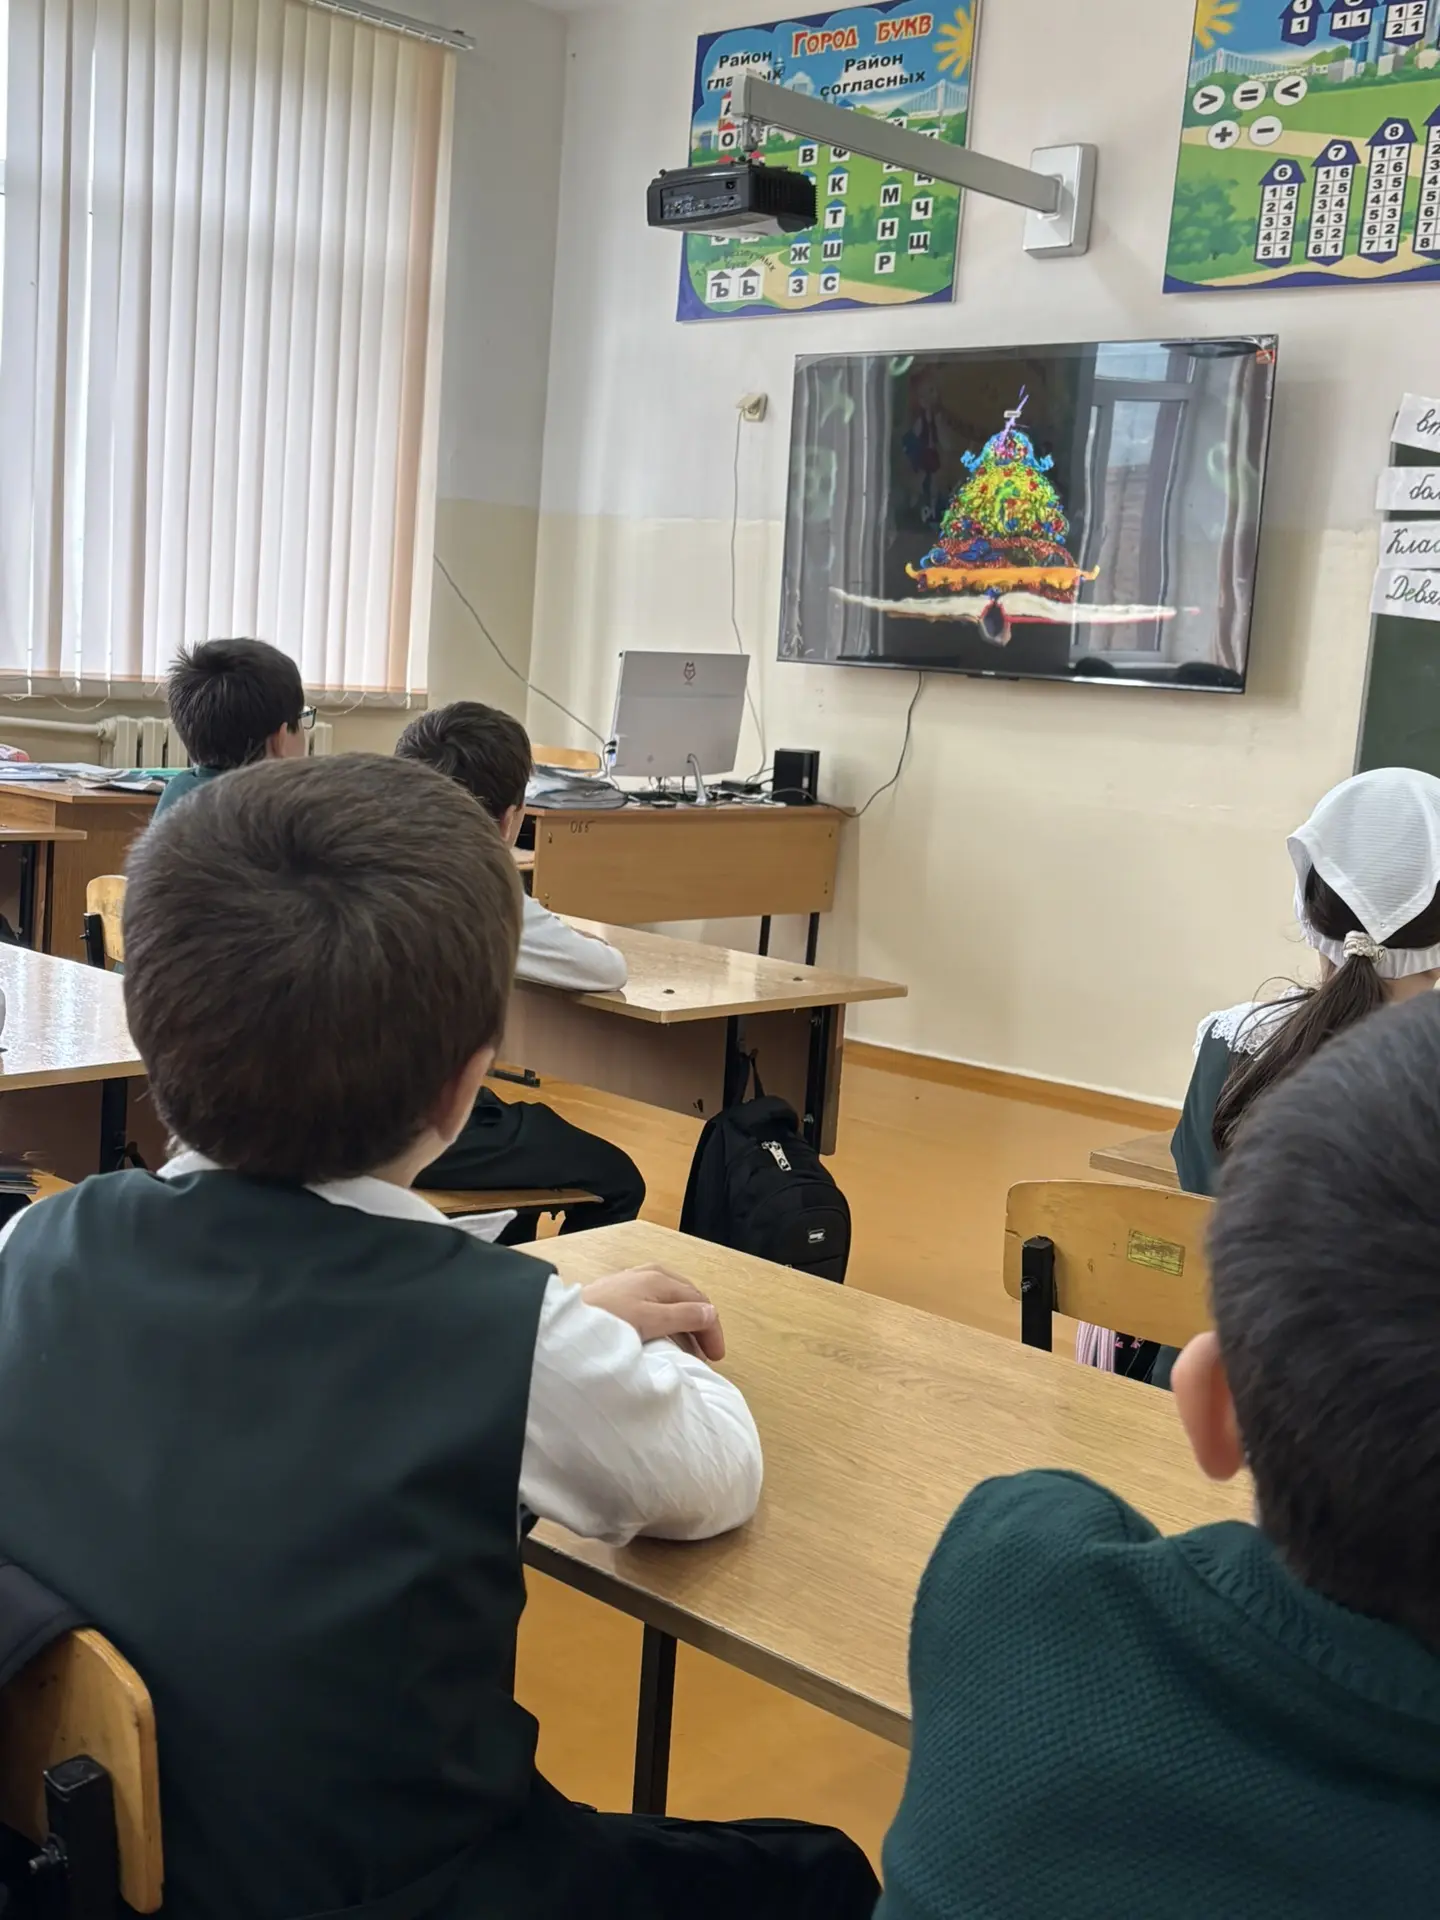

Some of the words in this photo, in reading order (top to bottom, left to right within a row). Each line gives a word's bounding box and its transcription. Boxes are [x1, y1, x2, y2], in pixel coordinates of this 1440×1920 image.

[1395, 6, 1404, 18] 1
[1412, 3, 1424, 17] 2
[1297, 19, 1305, 31] 1
[1339, 14, 1348, 26] 1
[1357, 11, 1366, 24] 1
[876, 13, 933, 43] БУКВ
[1391, 22, 1403, 35] 2
[1411, 20, 1420, 32] 1
[719, 50, 772, 68] Район
[844, 54, 904, 73] Район
[820, 70, 926, 97] согласных
[1389, 126, 1400, 138] 8
[802, 148, 814, 163] В
[1332, 147, 1343, 158] 7
[1378, 147, 1387, 159] 1
[1395, 145, 1406, 157] 7
[1374, 163, 1385, 175] 2
[1392, 161, 1403, 173] 6
[1430, 159, 1440, 171] 3
[1278, 167, 1288, 178] 6
[1322, 169, 1331, 180] 1
[1339, 167, 1350, 178] 6
[831, 176, 844, 192] К
[1372, 178, 1383, 190] 3
[1392, 176, 1402, 188] 5
[1427, 175, 1438, 186] 4
[882, 187, 899, 203] М
[1269, 187, 1277, 198] 1
[1285, 186, 1295, 197] 5
[1319, 183, 1330, 195] 2
[1337, 182, 1348, 193] 5
[1370, 194, 1381, 205] 4
[1388, 192, 1399, 203] 4
[1425, 190, 1437, 202] 5
[915, 200, 929, 216] Ч
[1266, 202, 1276, 213] 2
[1283, 200, 1294, 211] 4
[1317, 199, 1328, 210] 3
[1334, 197, 1345, 209] 4
[829, 209, 842, 224] Т
[1368, 209, 1379, 220] 5
[1387, 207, 1397, 219] 3
[1424, 206, 1434, 218] 6
[1264, 216, 1274, 228] 3
[1282, 215, 1292, 227] 3
[1315, 214, 1326, 225] 4
[1333, 213, 1343, 224] 3
[881, 221, 895, 237] Н
[1314, 228, 1324, 240] 5
[1331, 228, 1341, 239] 2
[1367, 224, 1377, 236] 6
[1384, 223, 1396, 234] 2
[1422, 222, 1433, 233] 7
[1262, 231, 1272, 242] 4
[1280, 230, 1291, 241] 2
[909, 234, 929, 252] Щ
[1312, 244, 1322, 255] 6
[1330, 243, 1339, 254] 1
[1365, 240, 1376, 251] 7
[1384, 238, 1393, 250] 1
[1419, 237, 1430, 249] 8
[791, 246, 811, 261] Ж
[823, 242, 841, 259] Ш
[1262, 246, 1271, 257] 5
[1278, 245, 1287, 256] 1
[878, 255, 891, 271] Р
[711, 282, 729, 298] Ъ
[742, 280, 756, 296] Ь
[822, 276, 837, 291] С
[1385, 575, 1440, 605] Девя
